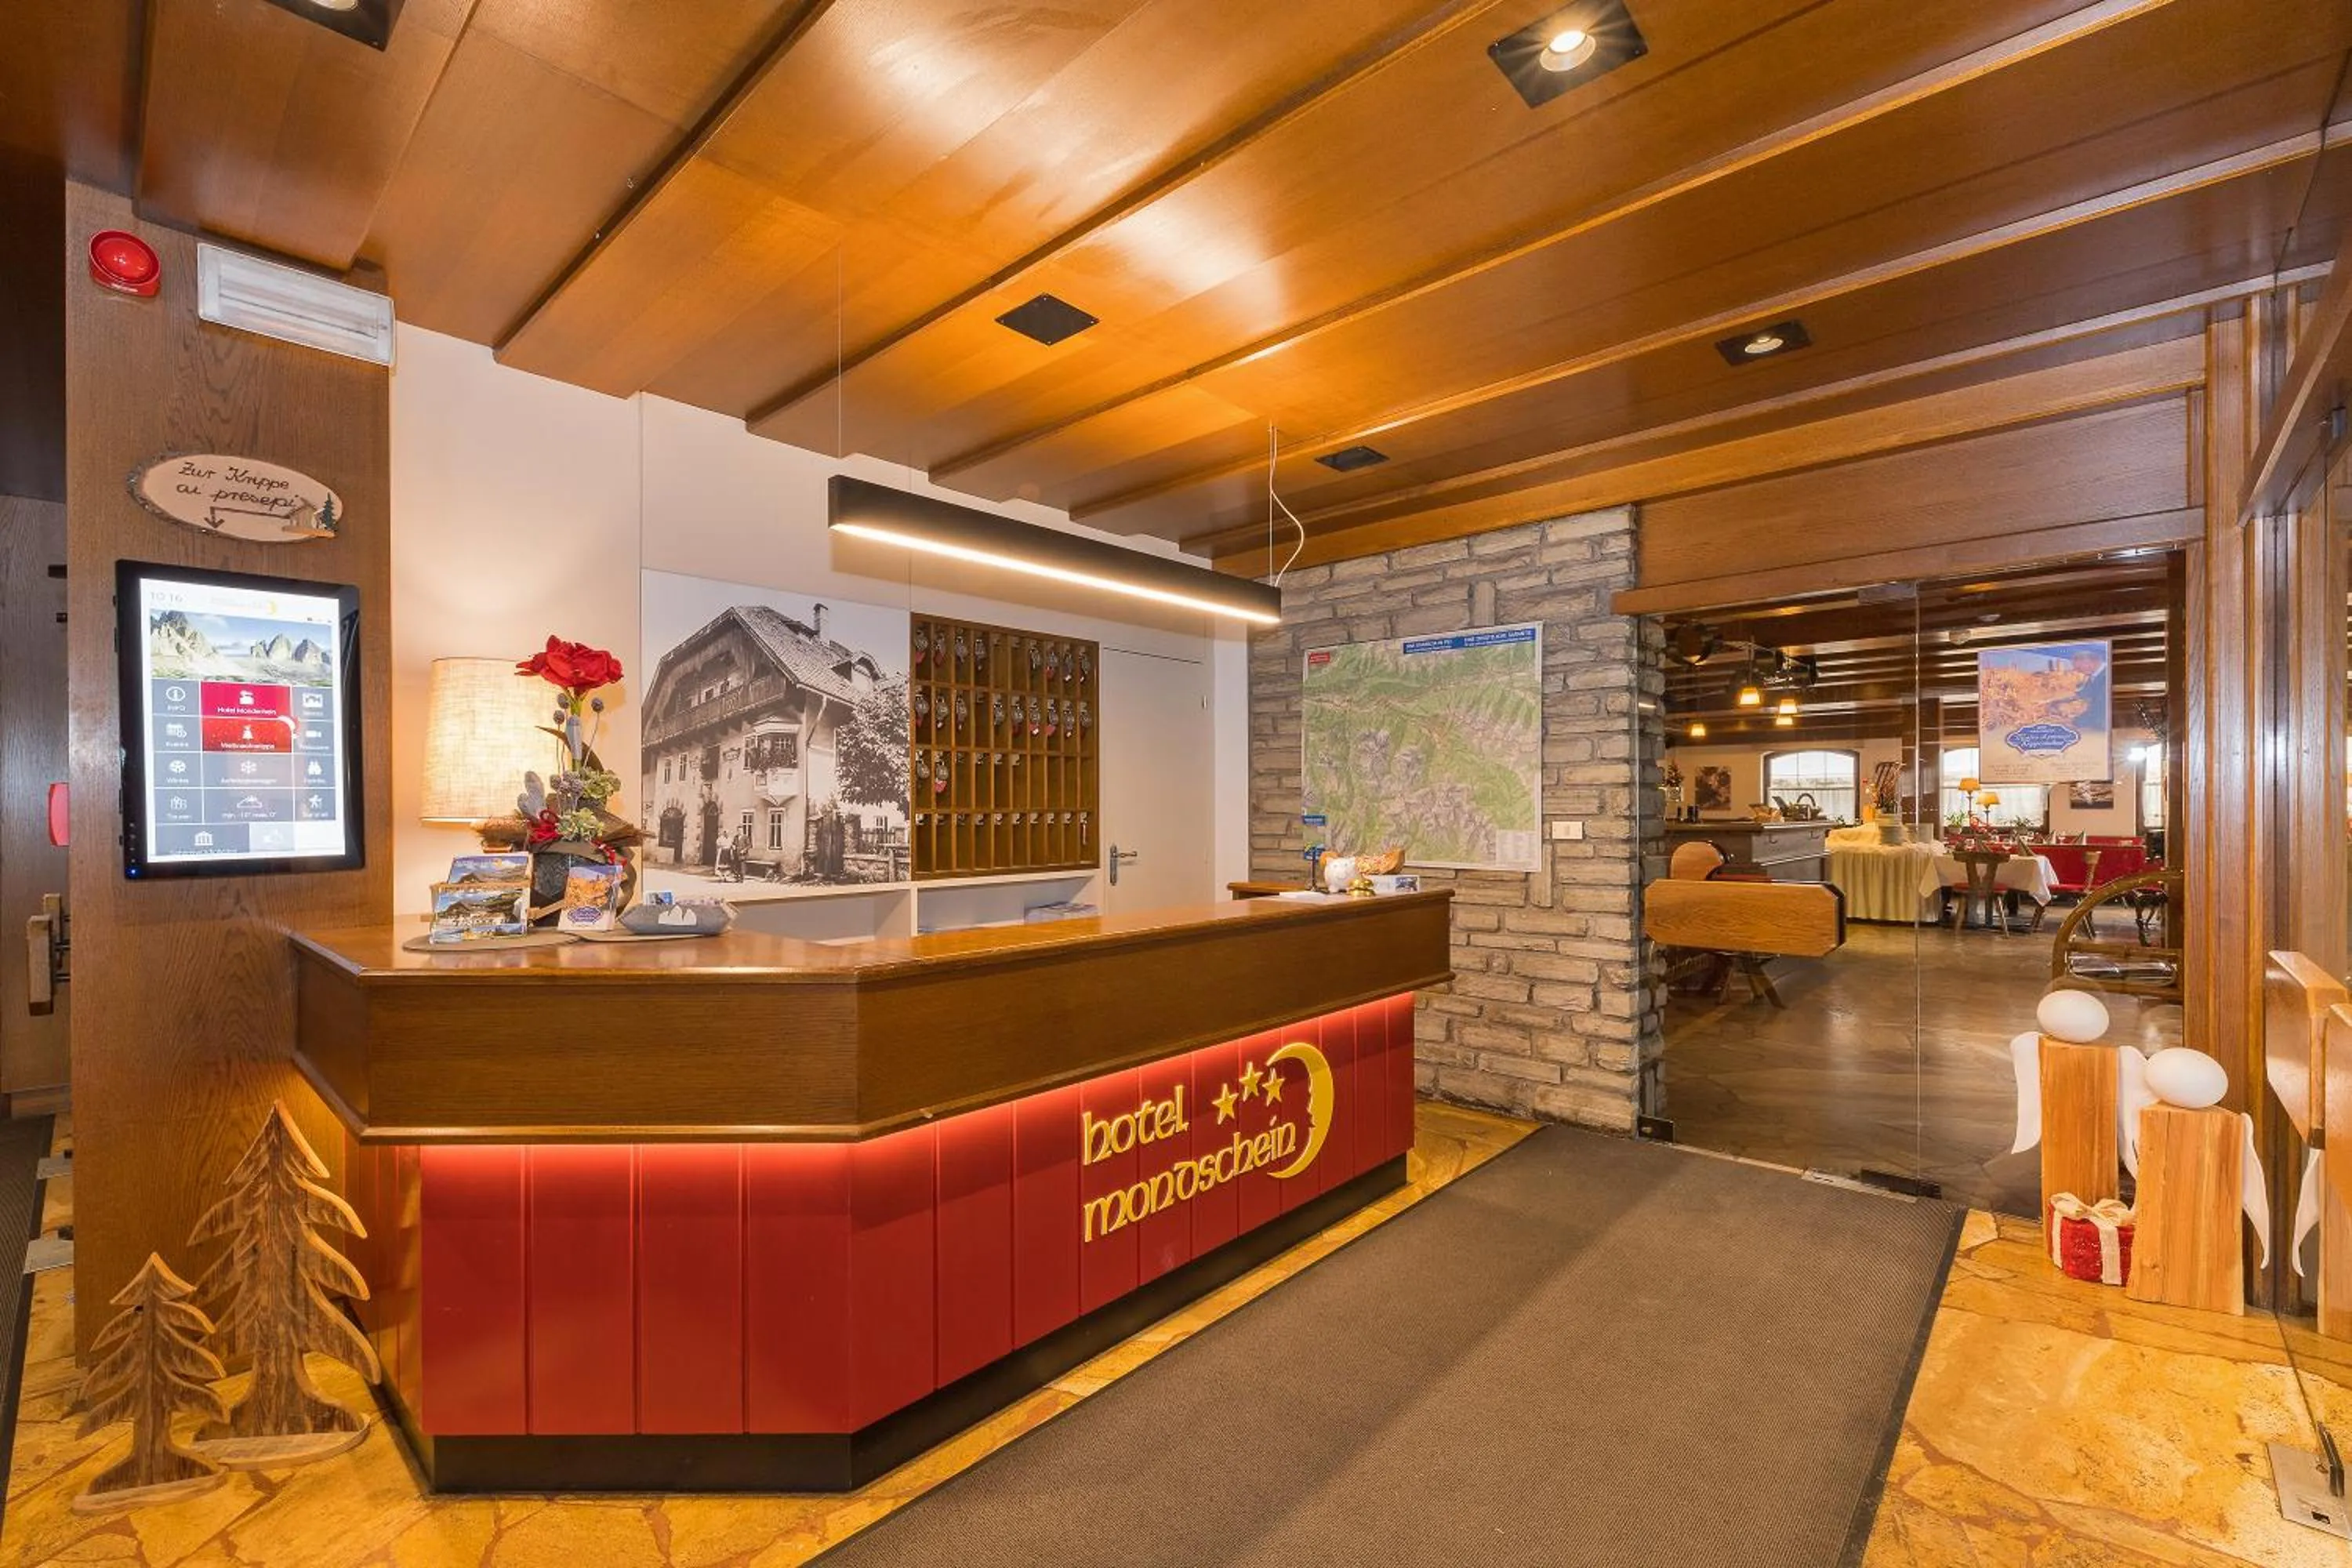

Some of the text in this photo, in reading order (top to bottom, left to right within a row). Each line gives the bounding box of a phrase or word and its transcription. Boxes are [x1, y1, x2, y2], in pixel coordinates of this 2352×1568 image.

[178, 462, 290, 492] Zur Krippe
[209, 490, 299, 511] presepi
[1082, 1084, 1189, 1166] hotel
[1083, 1115, 1296, 1243] mondschein
